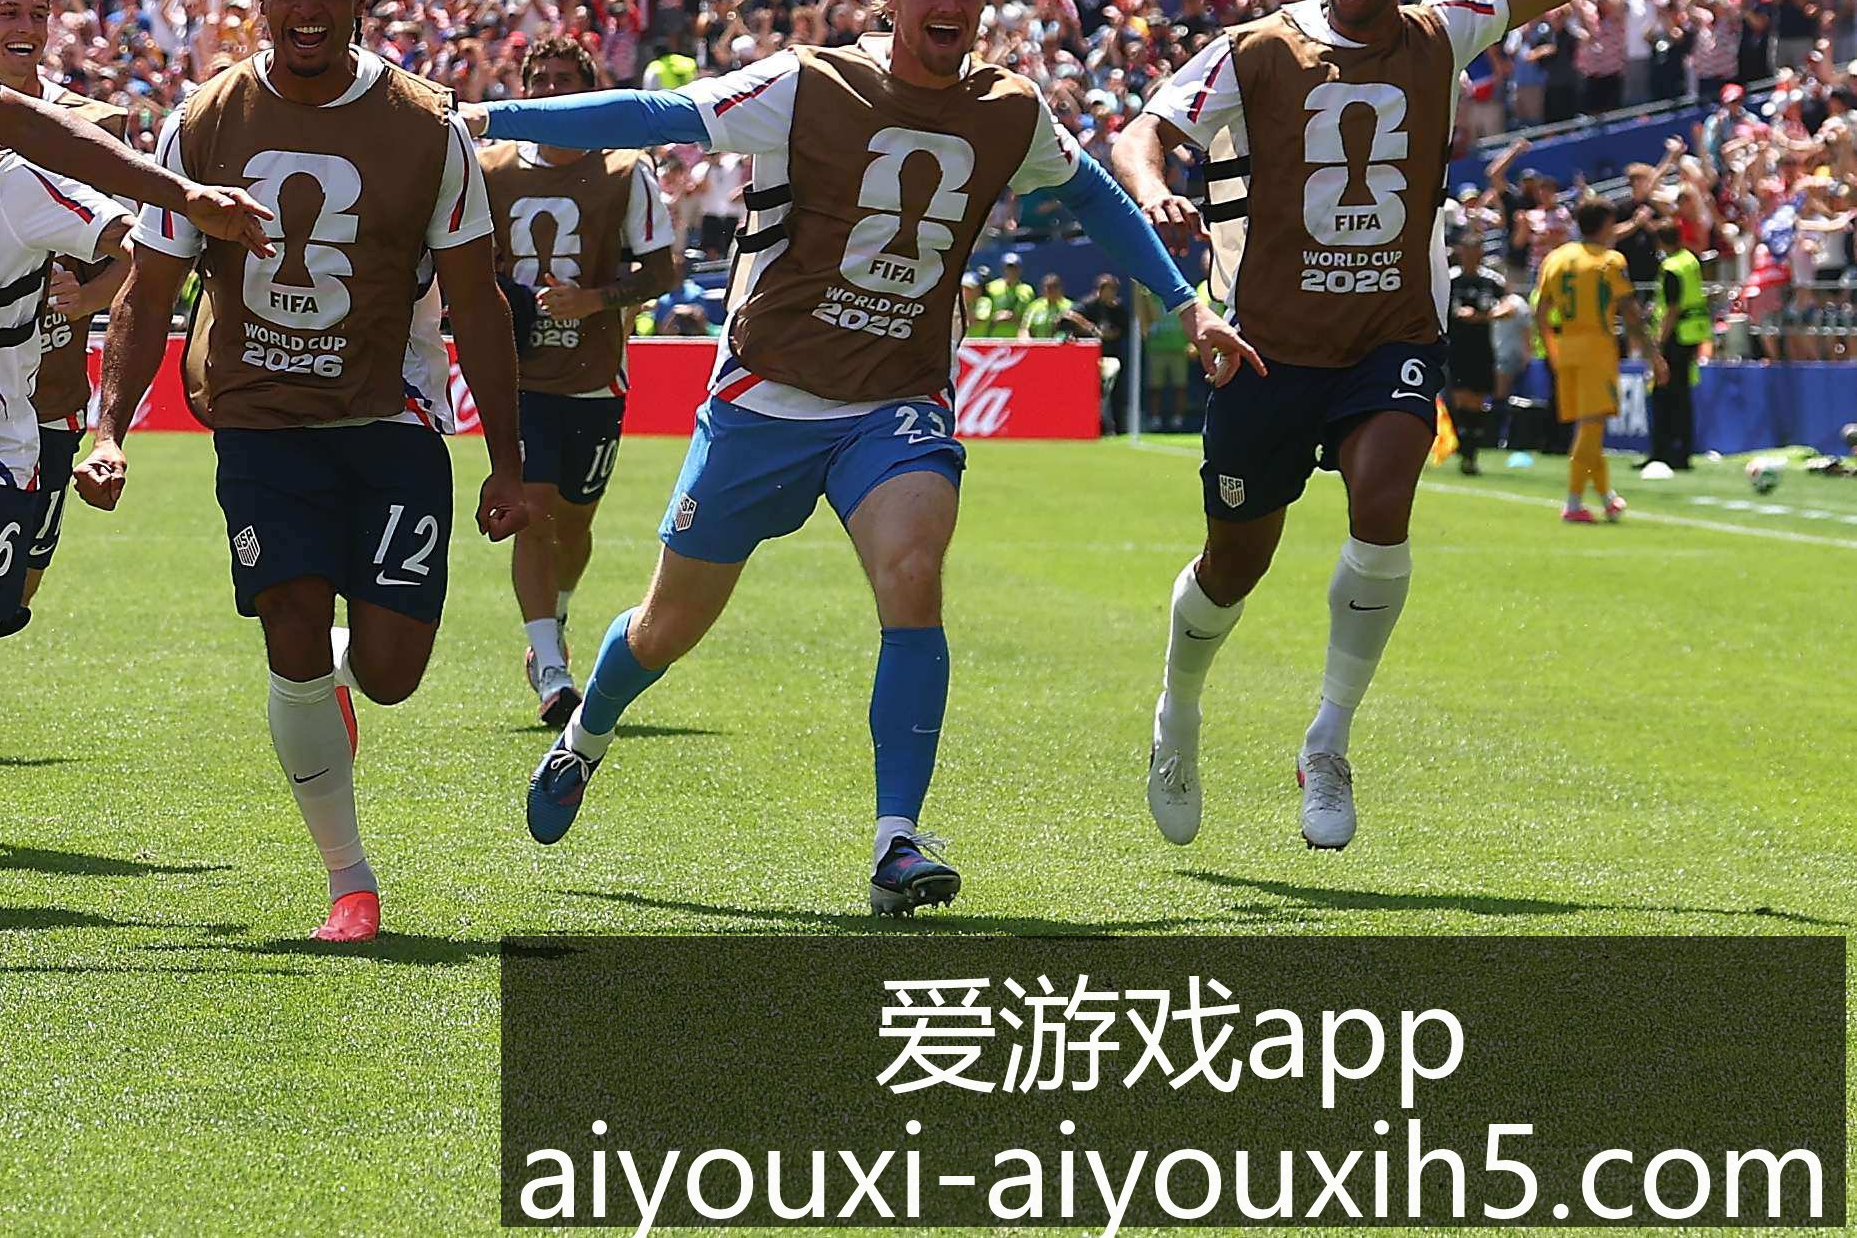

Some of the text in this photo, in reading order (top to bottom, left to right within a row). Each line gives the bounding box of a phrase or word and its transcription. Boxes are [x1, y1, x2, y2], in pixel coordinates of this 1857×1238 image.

[1336, 214, 1382, 231] FIFA
[1303, 250, 1403, 267] WORLD CUP
[869, 260, 916, 284] FIFA
[1301, 268, 1402, 293] 2026
[270, 291, 319, 314] FIFA
[825, 286, 891, 312] WORLD
[1562, 272, 1576, 319] 5
[811, 302, 914, 340] 2026
[243, 322, 347, 351] WORLD CUP
[242, 341, 344, 378] 2026
[1400, 358, 1427, 387] 6
[585, 439, 618, 483] 10
[1221, 476, 1242, 490] USA
[236, 528, 255, 549] USA
[372, 504, 440, 577] 12
